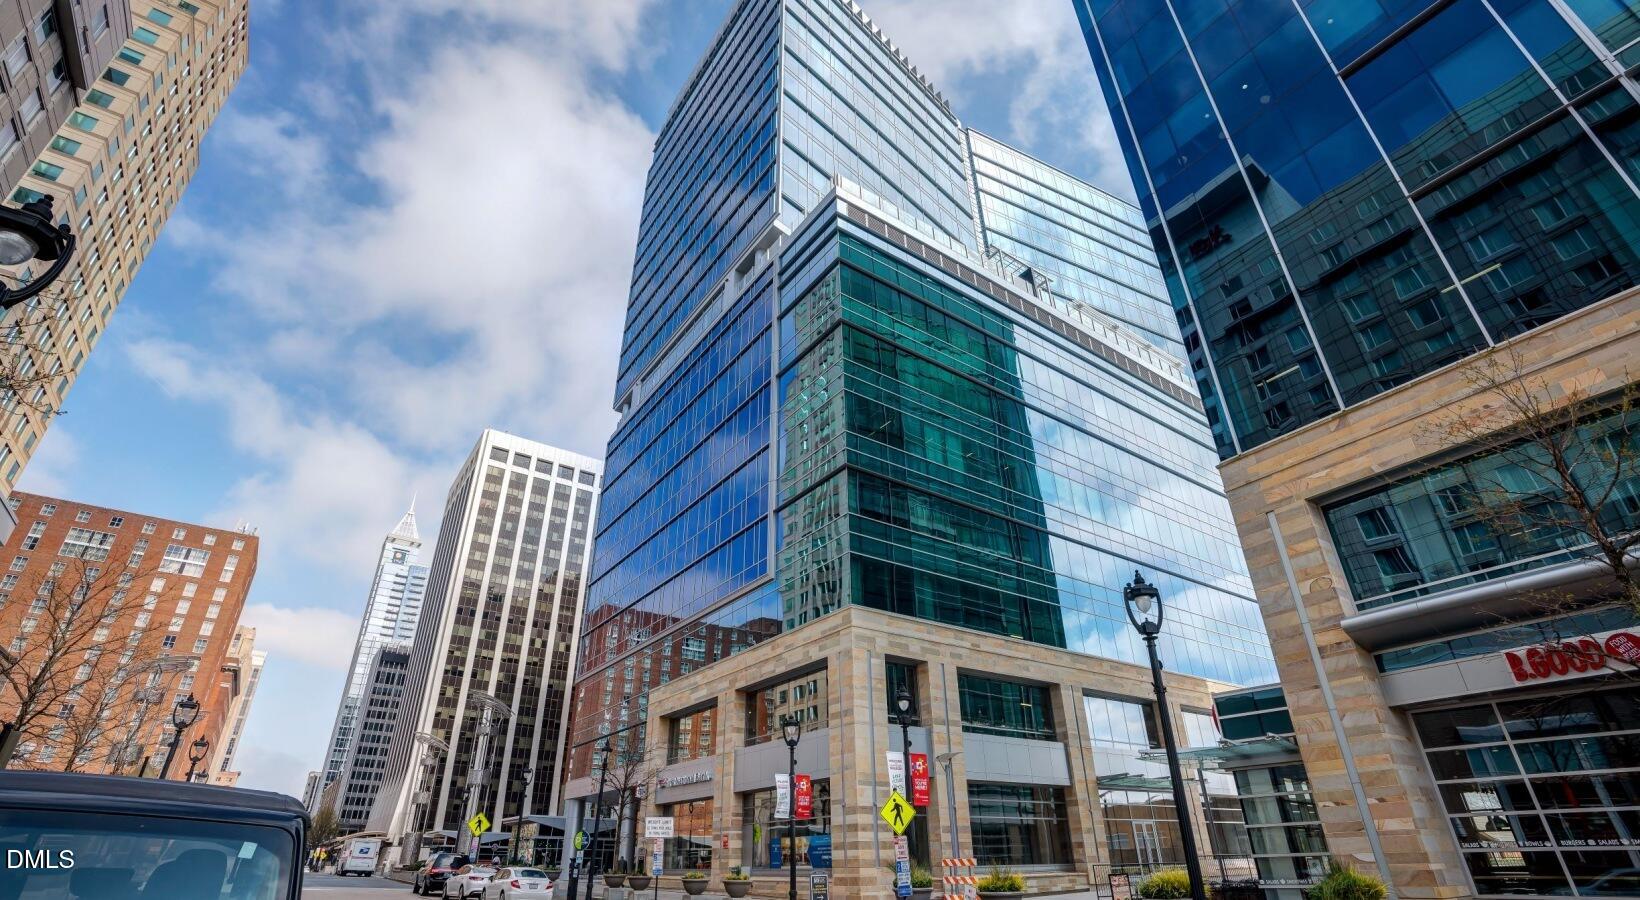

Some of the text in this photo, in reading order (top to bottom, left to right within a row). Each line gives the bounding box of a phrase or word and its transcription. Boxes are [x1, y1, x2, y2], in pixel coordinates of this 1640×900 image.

[1608, 636, 1627, 648] FOOD
[1616, 640, 1636, 653] WITH
[1504, 639, 1606, 681] B.GOOD
